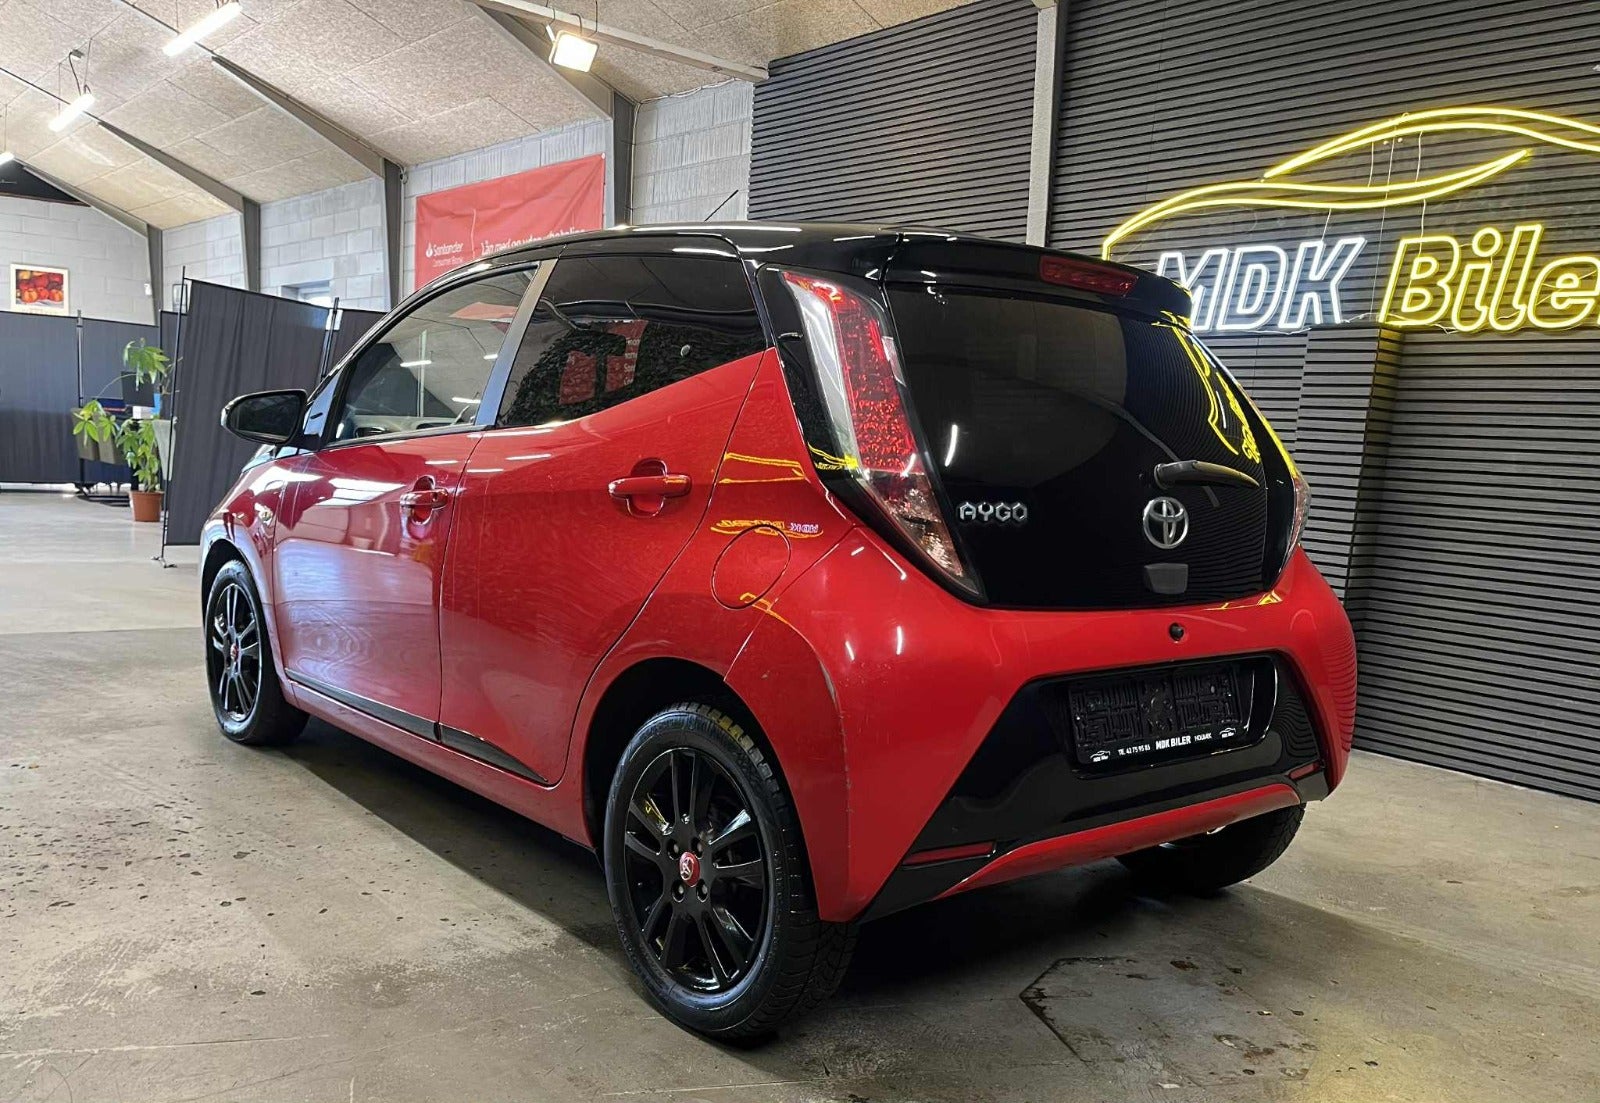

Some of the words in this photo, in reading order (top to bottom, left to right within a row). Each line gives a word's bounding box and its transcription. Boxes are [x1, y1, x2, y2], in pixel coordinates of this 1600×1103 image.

[433, 241, 464, 257] Santander
[1156, 236, 1368, 332] MDK
[1378, 223, 1600, 332] Bile
[959, 501, 1028, 522] AYGO
[1155, 738, 1170, 750] MDK
[1170, 735, 1191, 747] BILER
